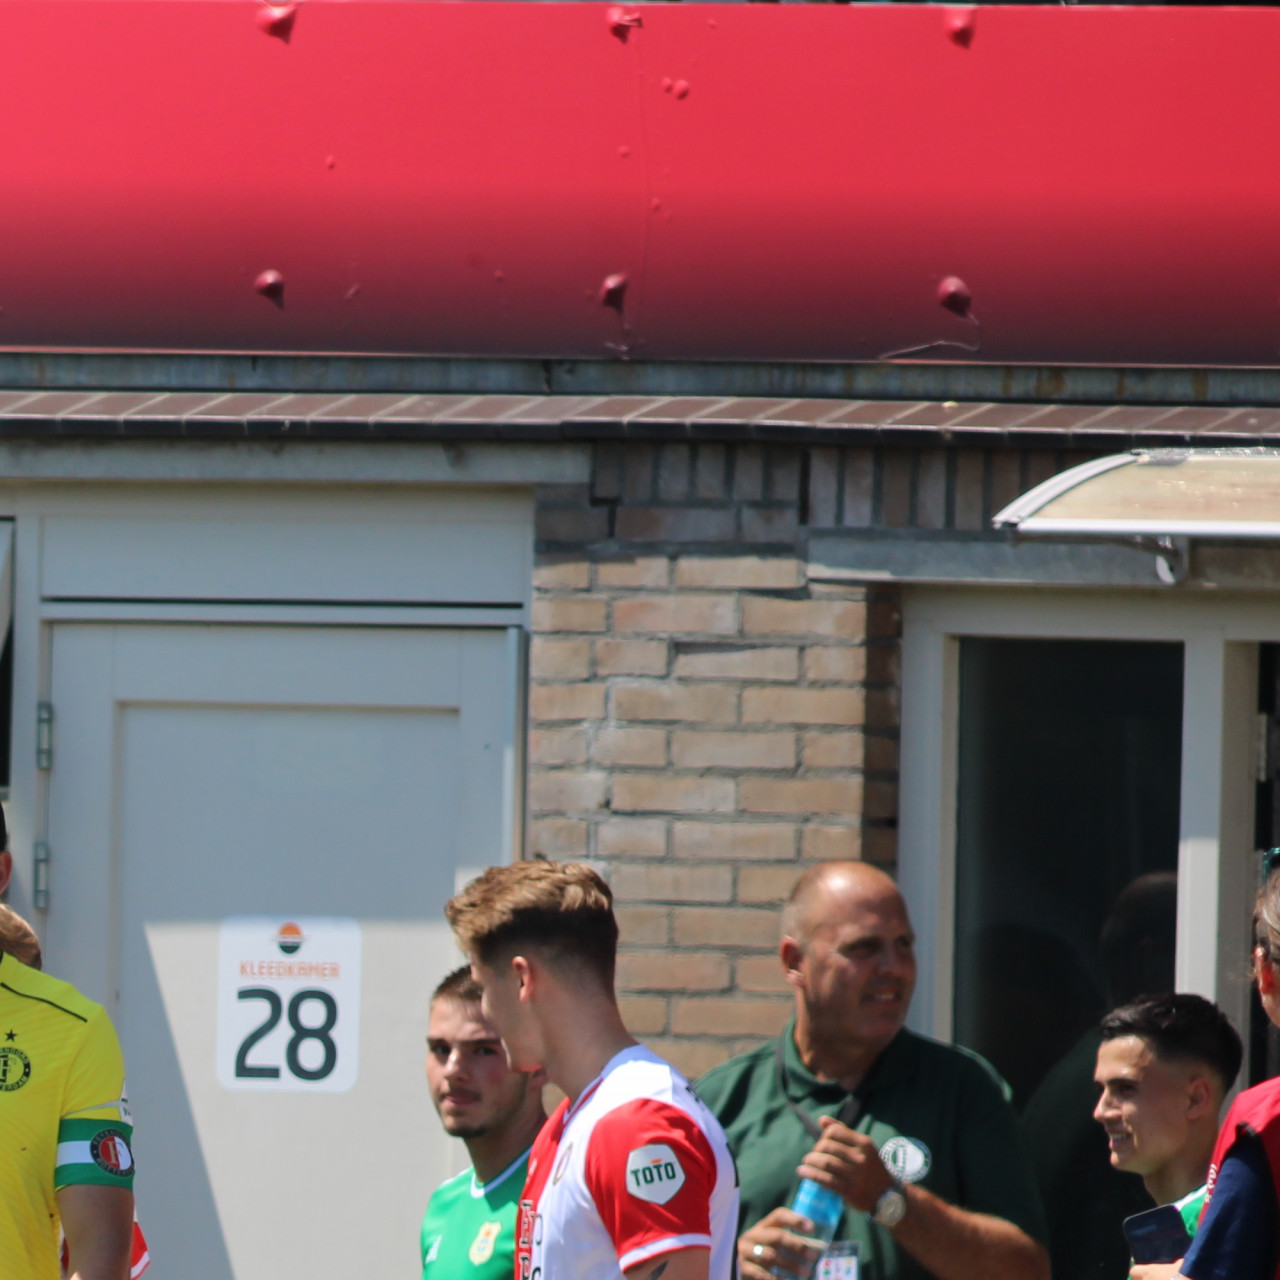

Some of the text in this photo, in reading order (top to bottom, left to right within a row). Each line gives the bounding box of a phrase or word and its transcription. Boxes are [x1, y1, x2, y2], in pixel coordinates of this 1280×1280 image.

[239, 959, 340, 980] KLEEDKAMER
[234, 986, 339, 1082] 28
[630, 1162, 676, 1187] TOTO
